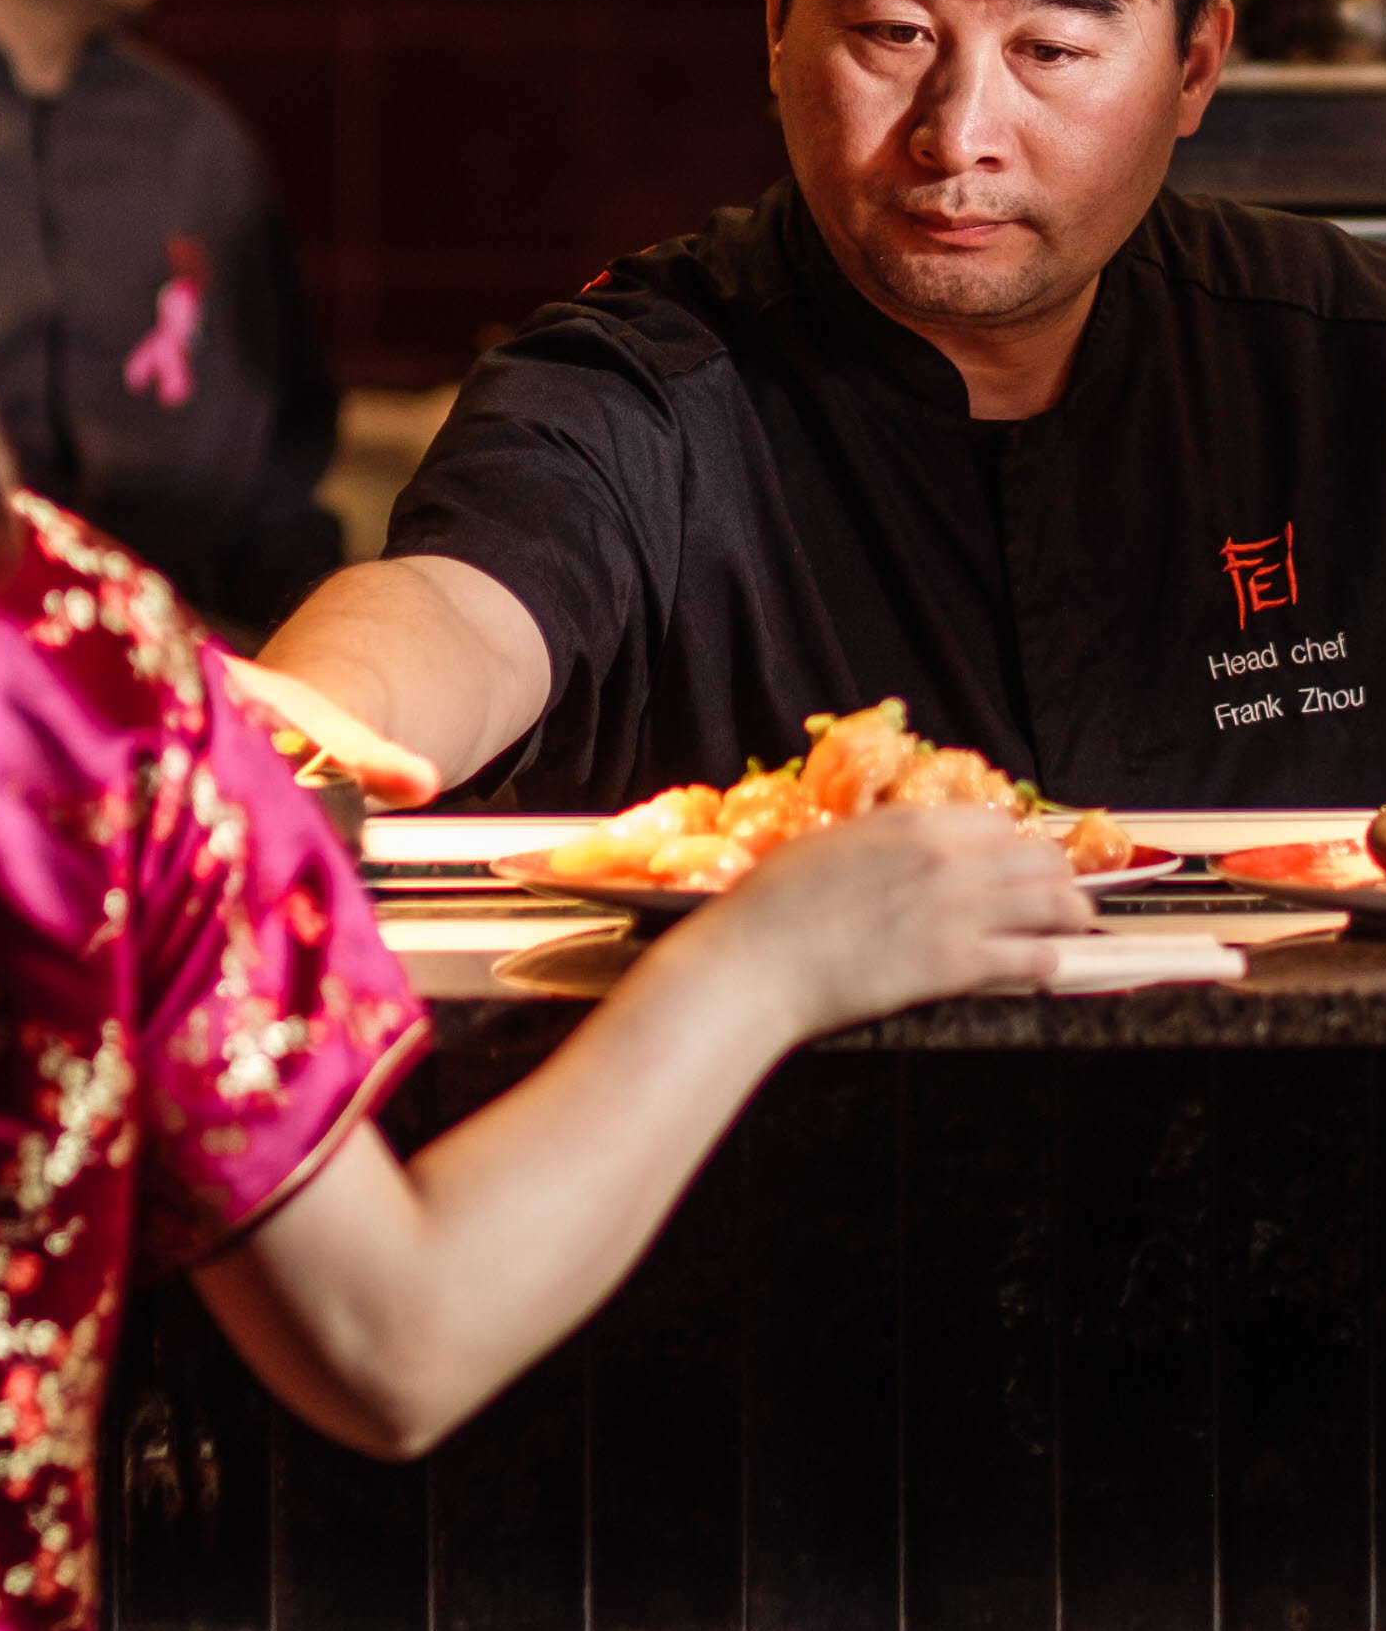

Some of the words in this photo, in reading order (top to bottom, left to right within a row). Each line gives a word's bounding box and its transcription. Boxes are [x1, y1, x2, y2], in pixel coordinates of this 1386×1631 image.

[1207, 641, 1278, 680] Head
[1290, 632, 1347, 665] chef
[1213, 693, 1284, 730] Frank
[1297, 686, 1366, 714] Zhou
